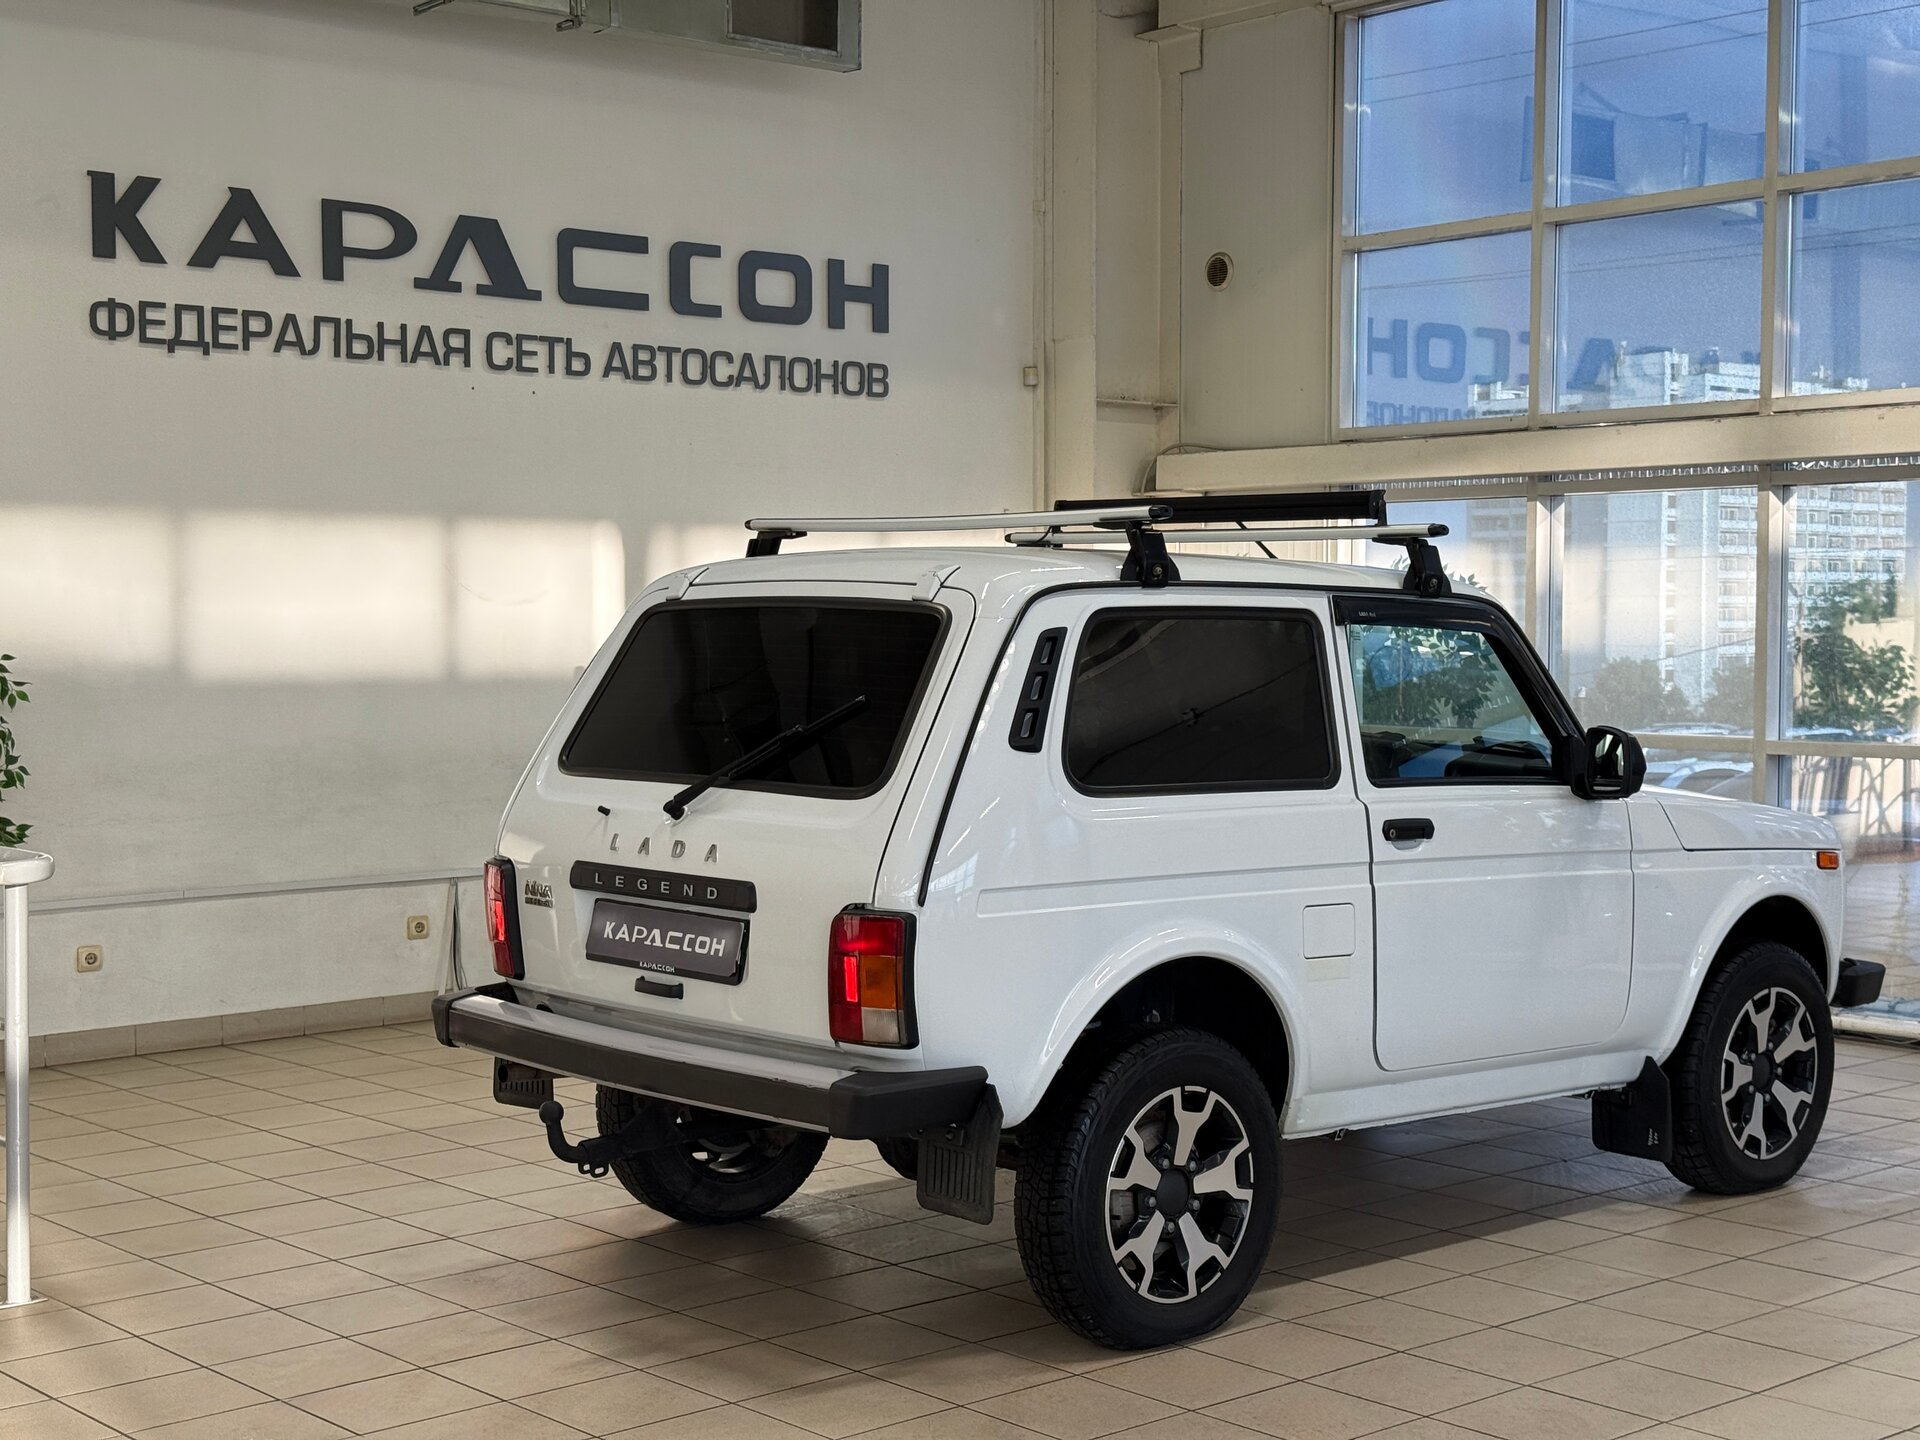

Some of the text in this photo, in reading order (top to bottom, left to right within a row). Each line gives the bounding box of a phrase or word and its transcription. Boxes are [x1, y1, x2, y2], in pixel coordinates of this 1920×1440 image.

[89, 297, 890, 398] ФЕДЕРАЛЬНАЯ СЕТЬ АВТОСАЛОНОВ
[609, 833, 718, 863] LADA
[594, 872, 719, 900] LEGEND
